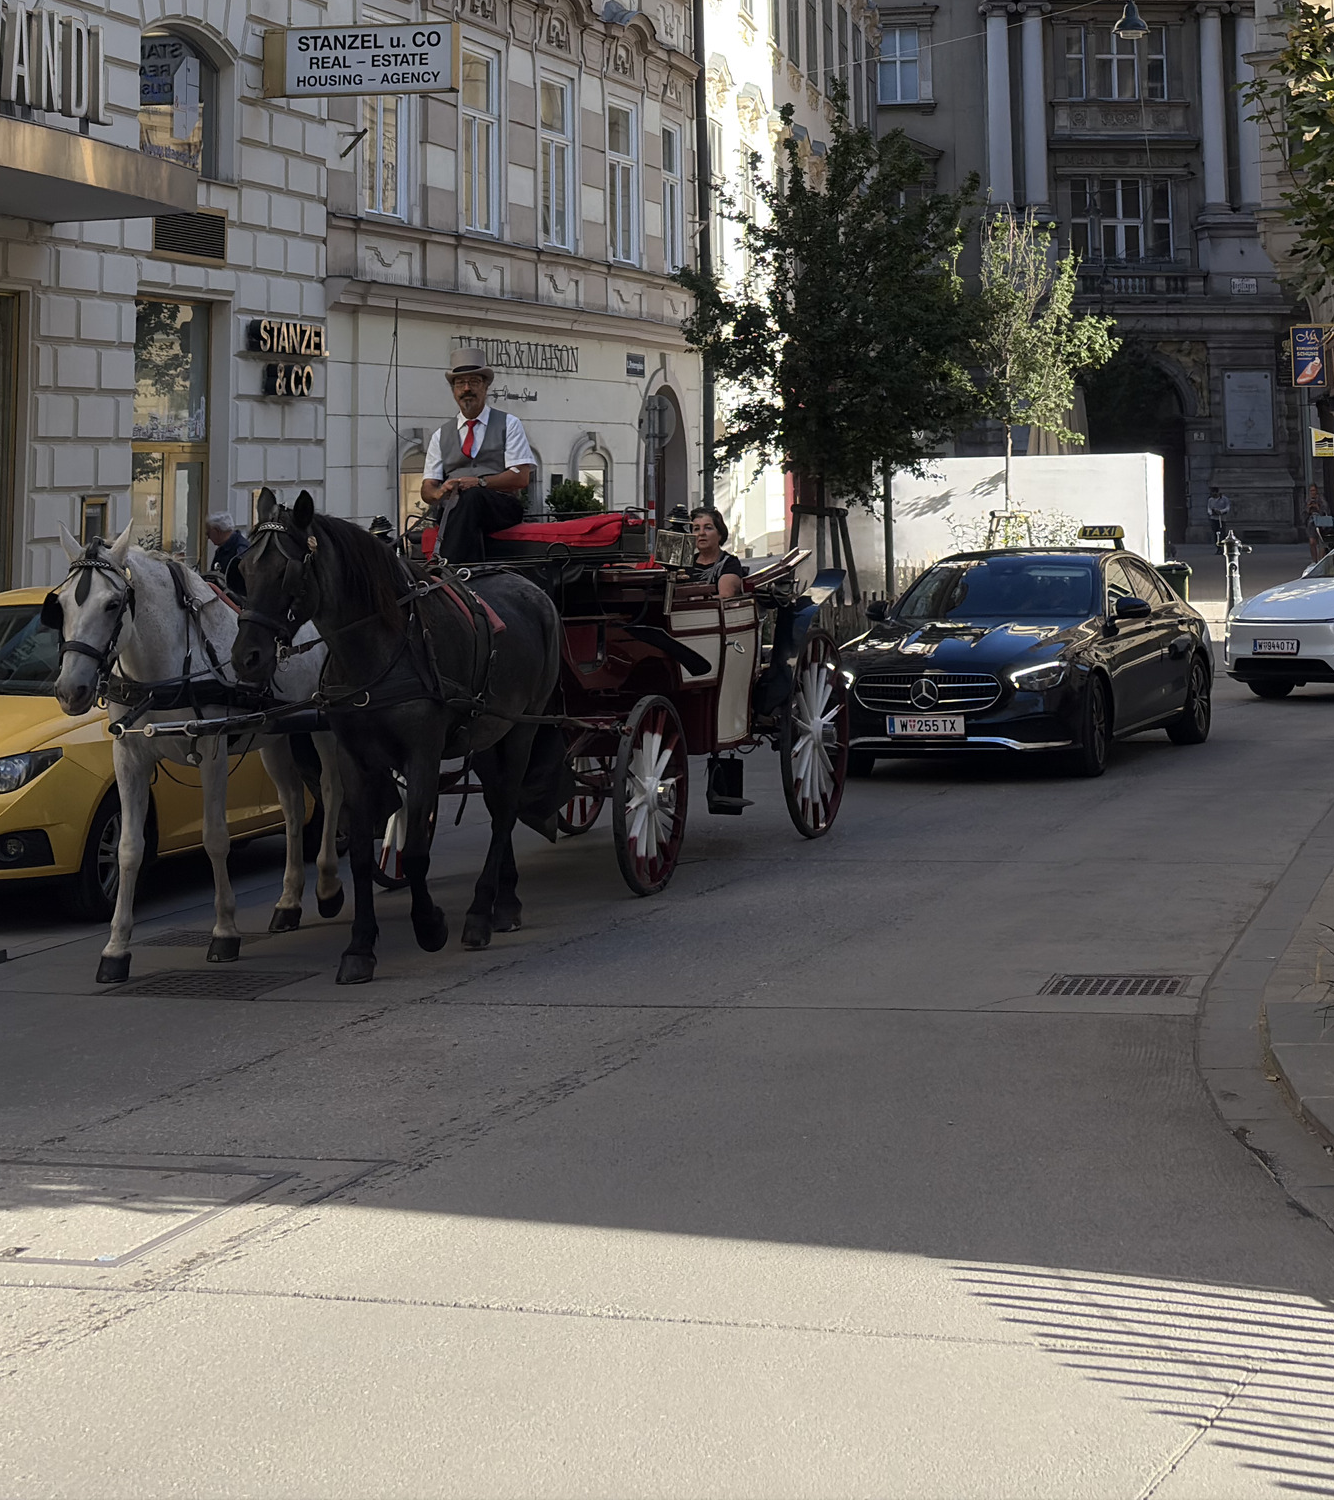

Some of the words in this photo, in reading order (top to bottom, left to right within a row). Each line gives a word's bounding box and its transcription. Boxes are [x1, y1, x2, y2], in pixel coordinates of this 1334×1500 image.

[297, 33, 384, 52] STANZEL
[389, 36, 406, 49] u.
[412, 31, 441, 48] CO
[309, 55, 351, 70] REAL
[371, 52, 429, 68] ESTATE
[296, 74, 363, 88] HOUSING
[380, 71, 441, 85] AGENCY
[260, 319, 330, 357] STANZEL
[514, 340, 524, 370] &
[527, 342, 579, 373] MAISON
[275, 363, 287, 396] &
[290, 364, 314, 397] CO
[1085, 527, 1115, 536] TAXI
